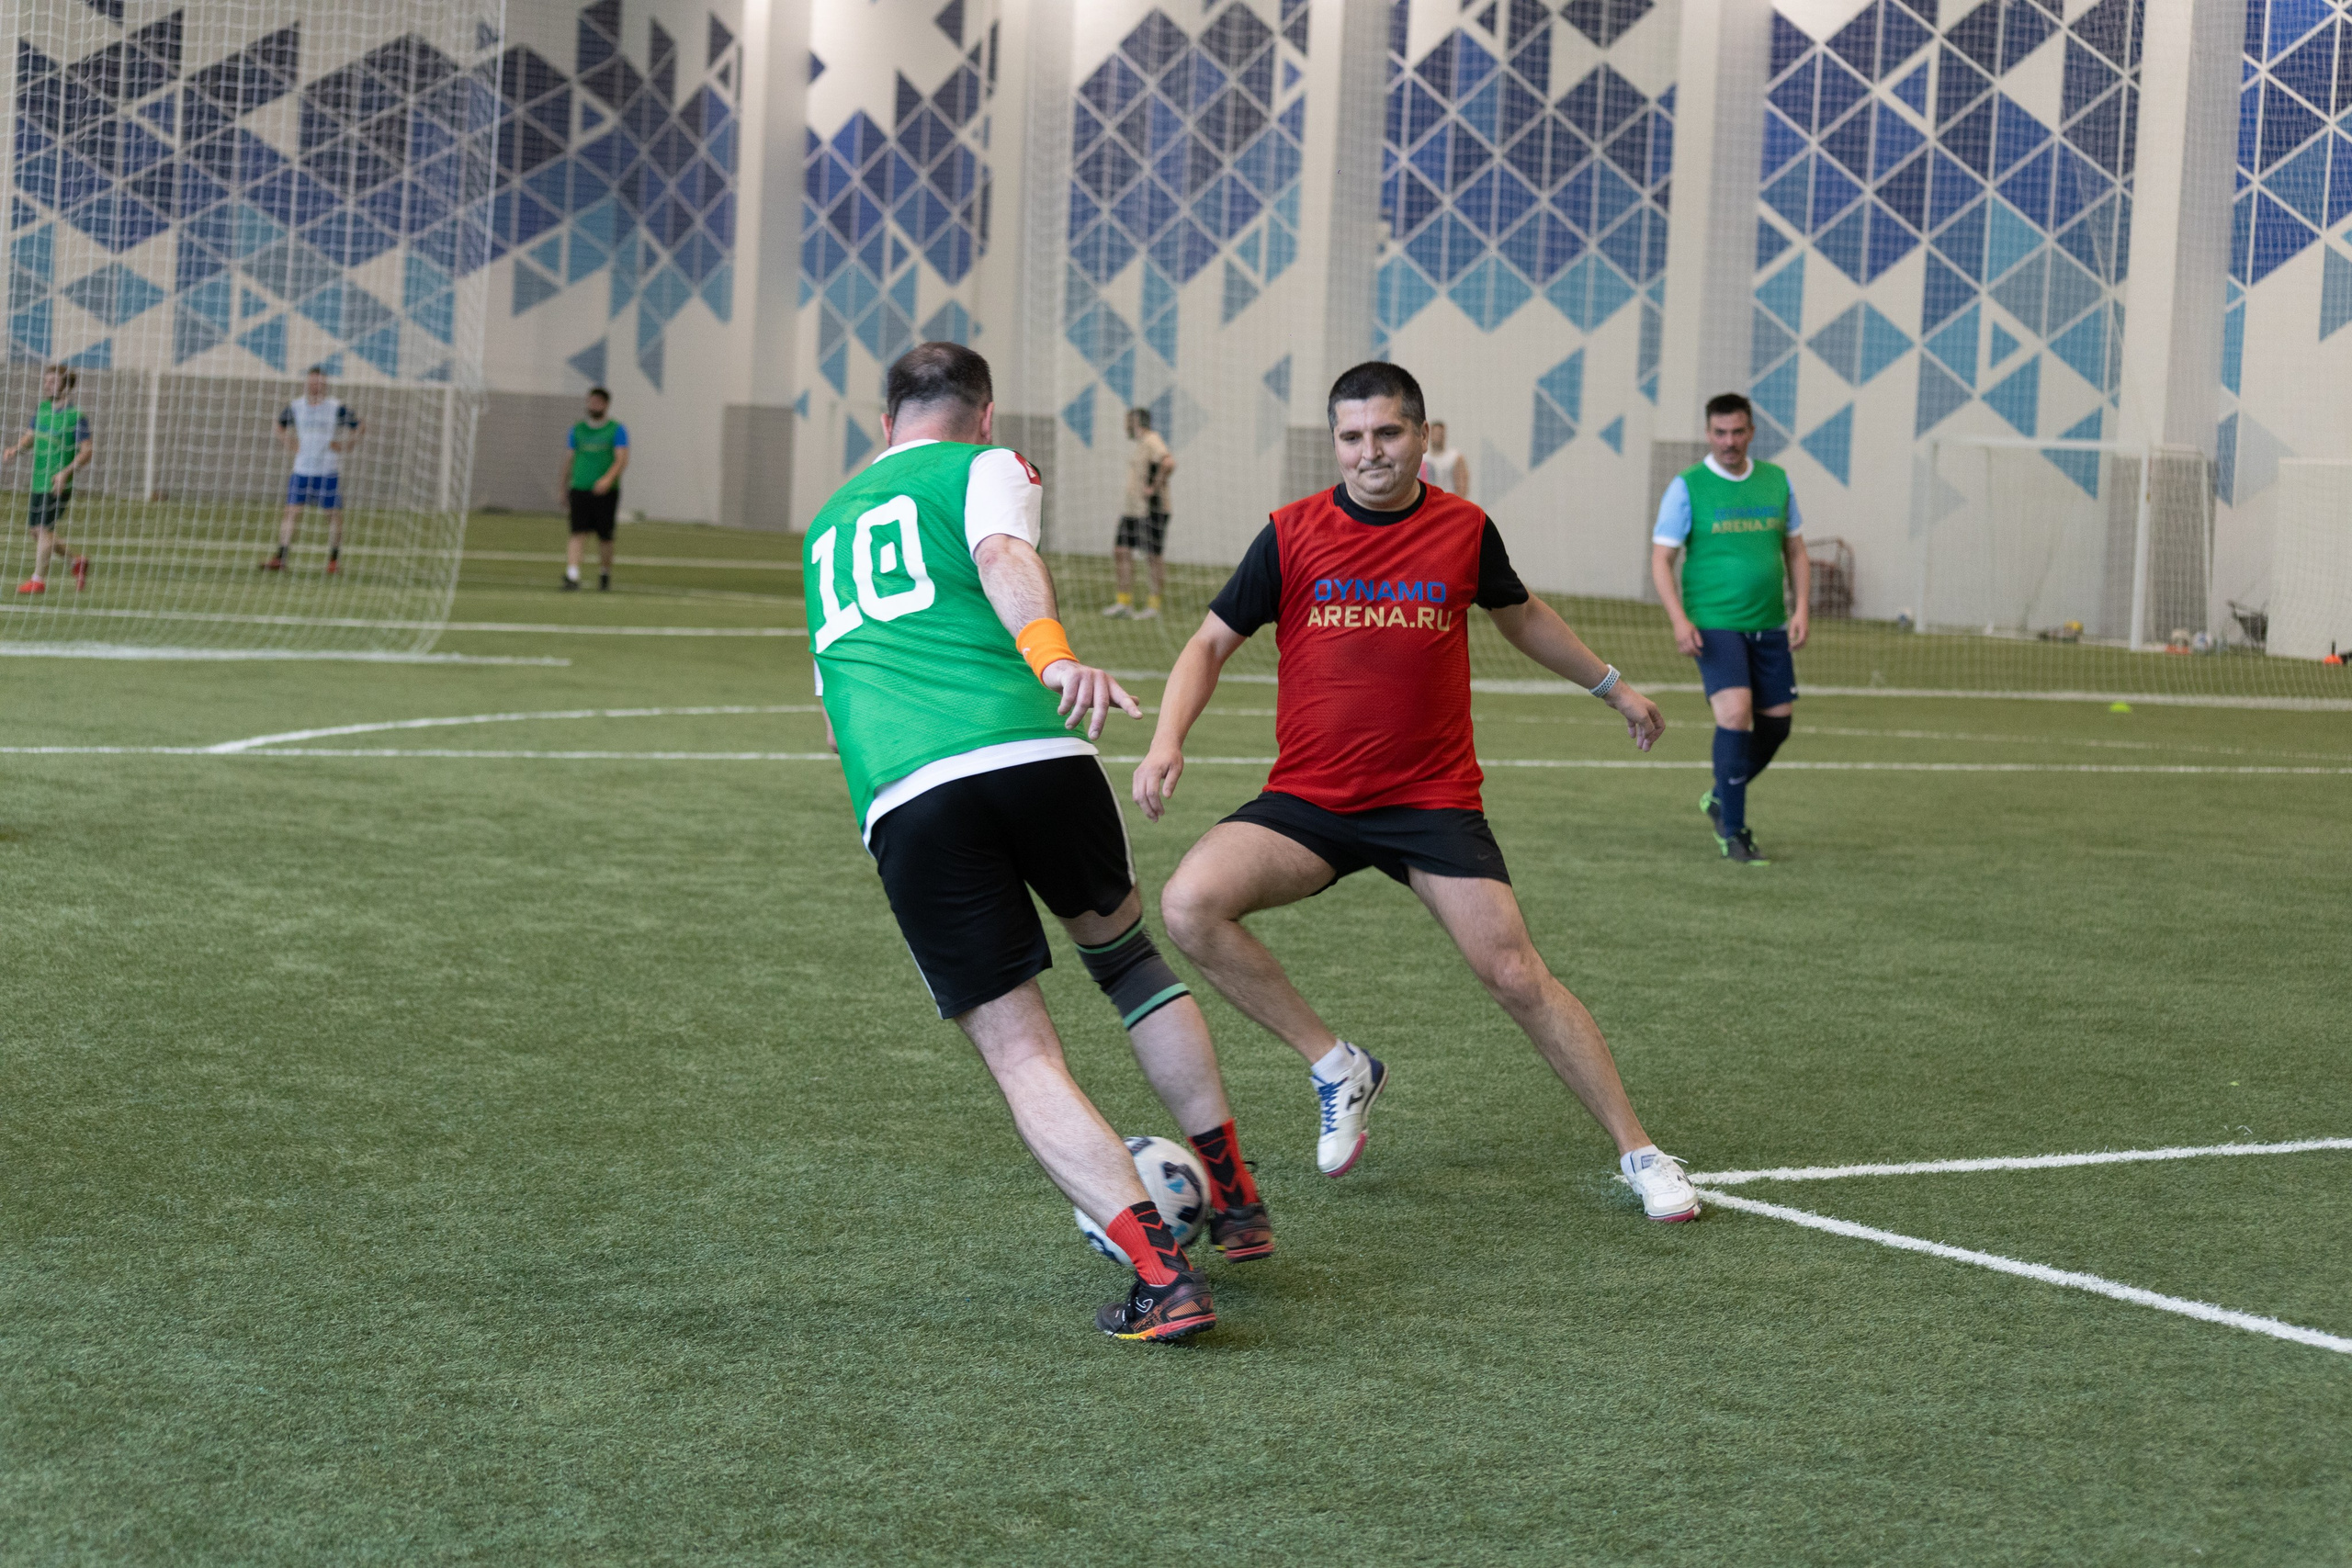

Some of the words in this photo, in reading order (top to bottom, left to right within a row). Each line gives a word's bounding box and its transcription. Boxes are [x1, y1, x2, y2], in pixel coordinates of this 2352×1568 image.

[811, 494, 935, 654] 10
[1315, 578, 1447, 604] DYNAMO
[1307, 605, 1453, 632] ARENA.RU
